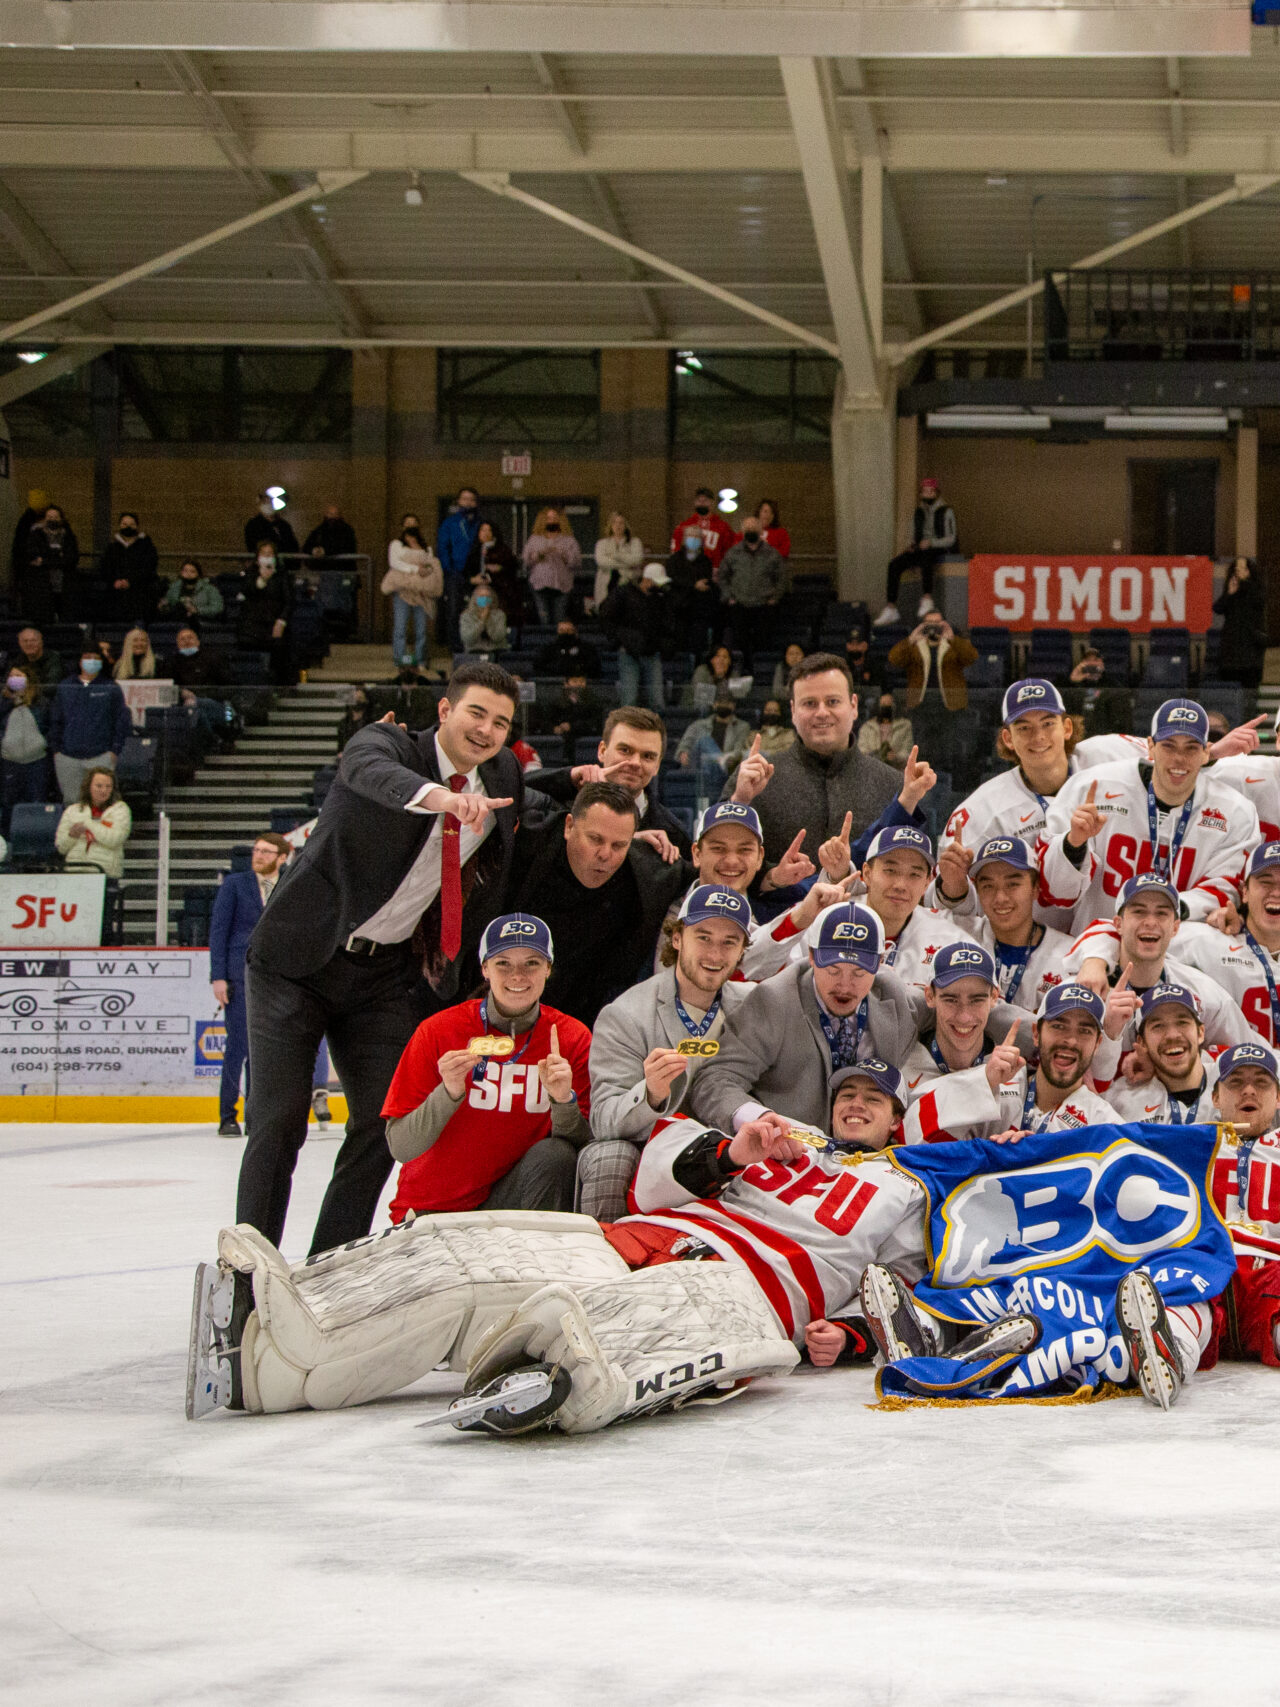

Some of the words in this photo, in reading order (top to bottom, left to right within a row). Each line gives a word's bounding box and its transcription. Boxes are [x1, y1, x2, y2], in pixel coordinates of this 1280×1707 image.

[993, 566, 1189, 622] SIMON
[709, 893, 740, 911] BC
[505, 921, 536, 937] BC
[837, 922, 868, 940] BC
[956, 950, 983, 964] BC
[97, 963, 160, 974] WAY
[1066, 987, 1093, 1001] BC
[205, 1035, 226, 1051] NAP
[21, 1047, 82, 1055] DOUGLAS
[85, 1047, 124, 1056] ROAD,
[128, 1047, 188, 1055] BURNABY
[11, 1062, 49, 1072] (604)
[54, 1062, 122, 1071] 298-7759
[986, 1151, 1193, 1262] BC
[635, 1352, 726, 1401] CCM
